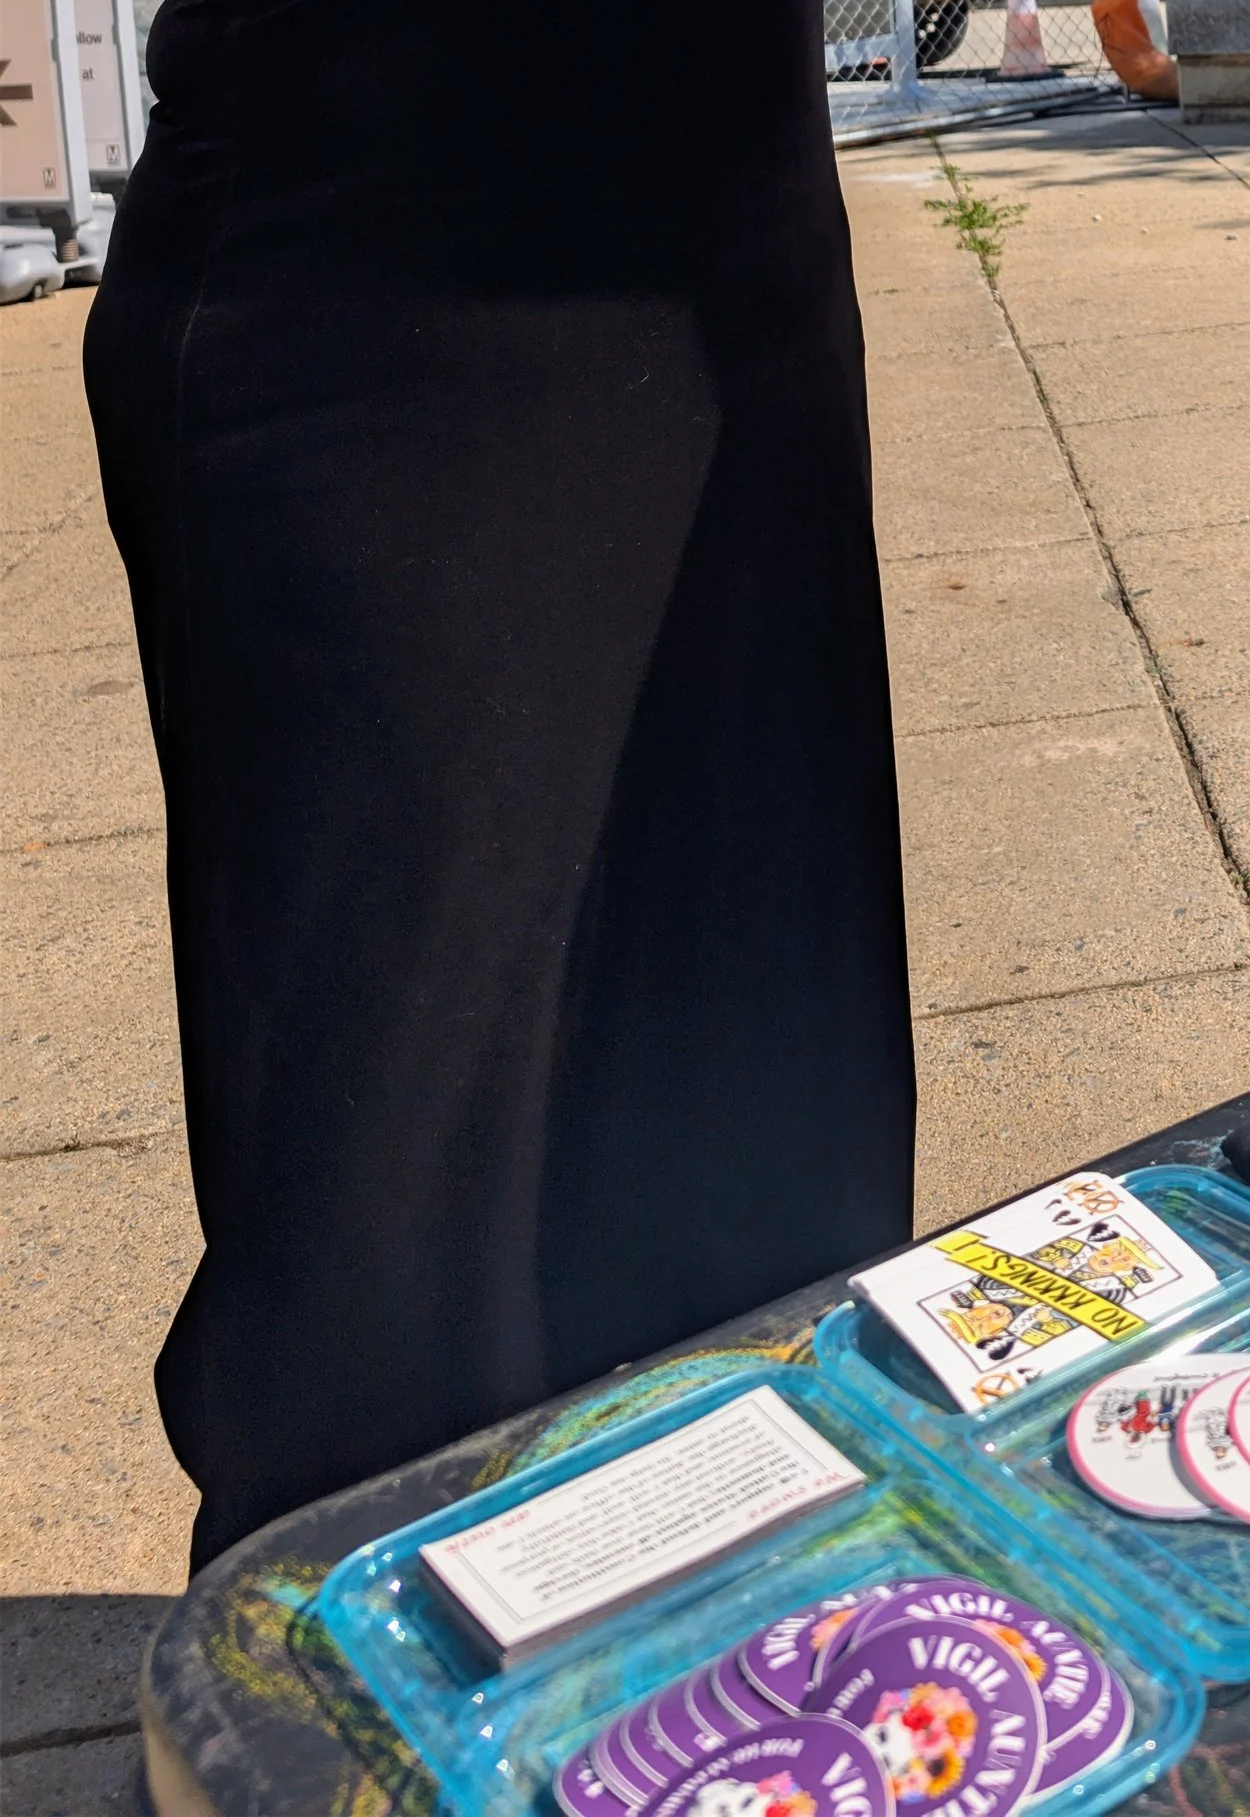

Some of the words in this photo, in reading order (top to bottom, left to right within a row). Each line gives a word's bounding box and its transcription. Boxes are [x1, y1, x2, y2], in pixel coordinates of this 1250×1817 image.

[82, 67, 94, 80] at
[1090, 1308, 1139, 1337] NO
[907, 1635, 1011, 1703] VIGIL
